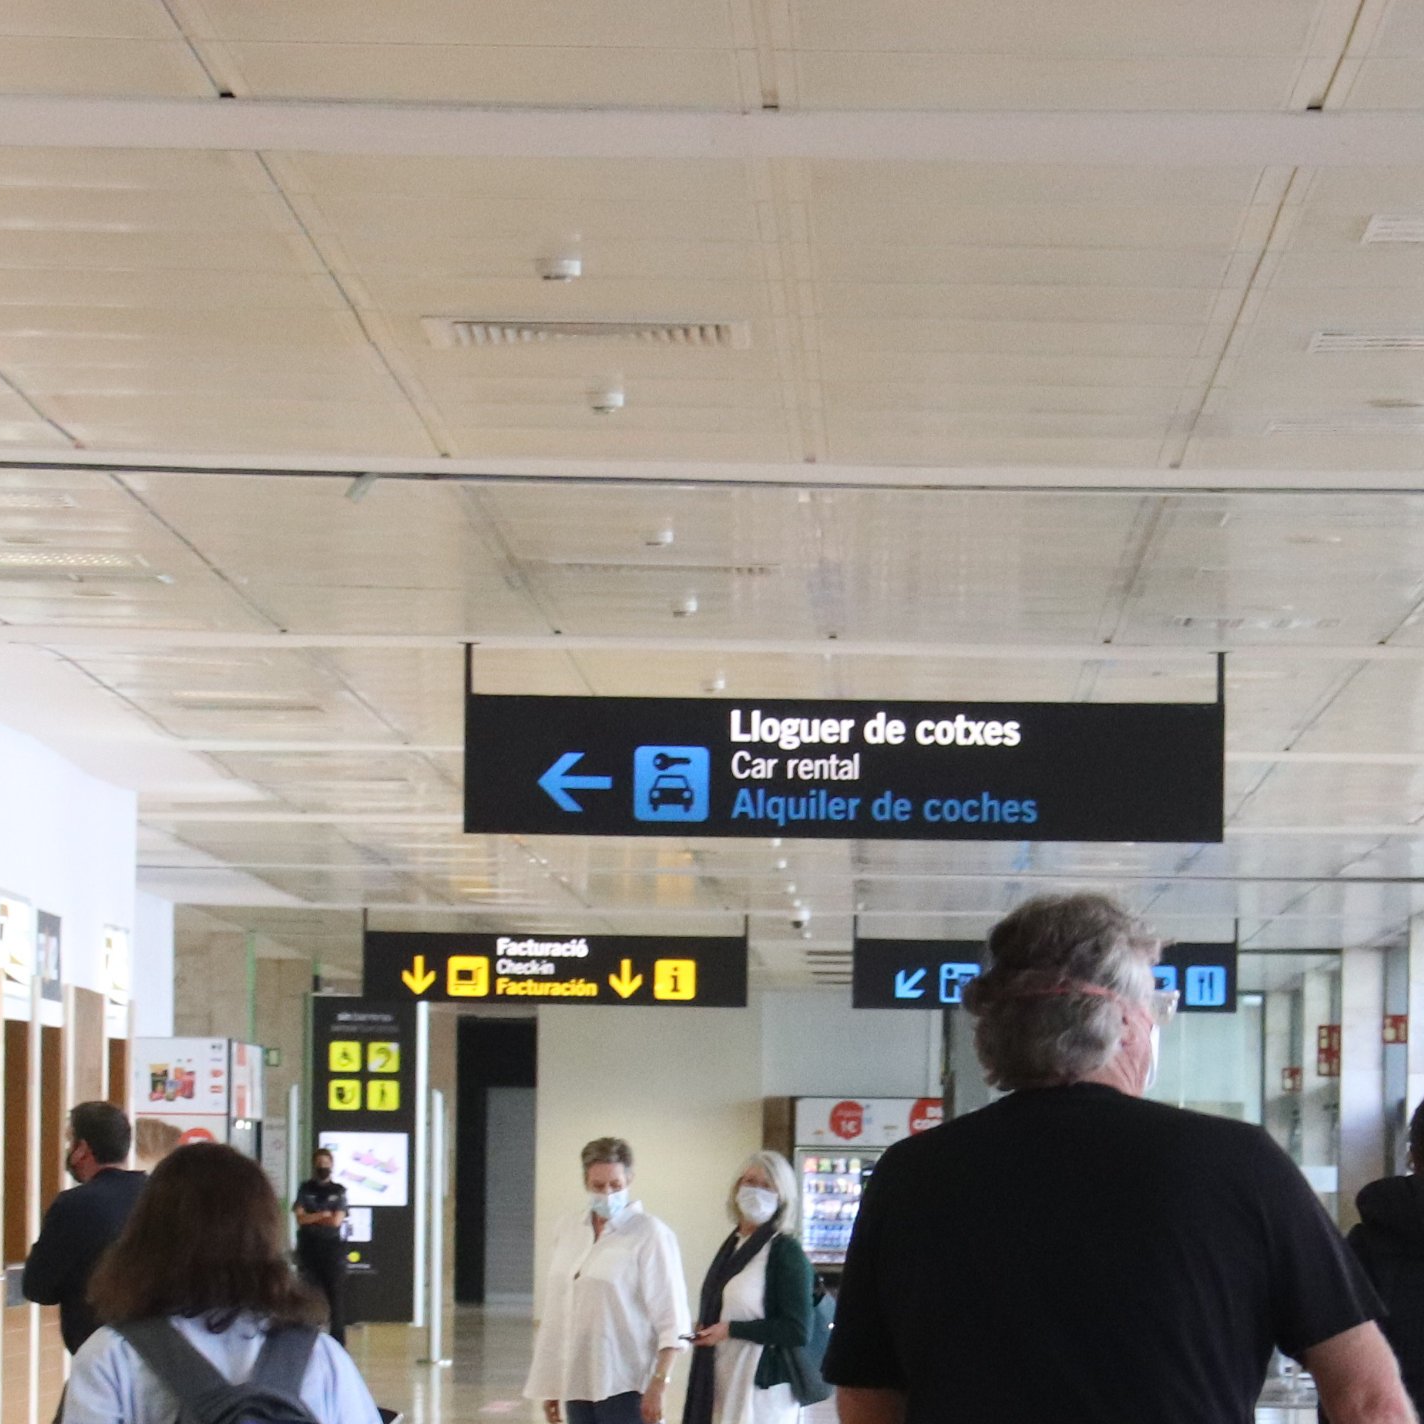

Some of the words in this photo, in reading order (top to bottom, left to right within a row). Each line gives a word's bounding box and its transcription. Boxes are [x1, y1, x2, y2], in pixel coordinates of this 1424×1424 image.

[730, 708, 855, 750] Lloguer
[863, 711, 906, 745] de
[915, 714, 1021, 746] cotxes
[731, 750, 779, 780] Car
[787, 752, 861, 781] rental
[731, 787, 861, 827] Alquiler
[871, 790, 912, 822] de
[924, 791, 1038, 824] coches
[495, 937, 589, 958] Facturació
[495, 958, 556, 976] Check-in
[495, 977, 599, 997] Facturación
